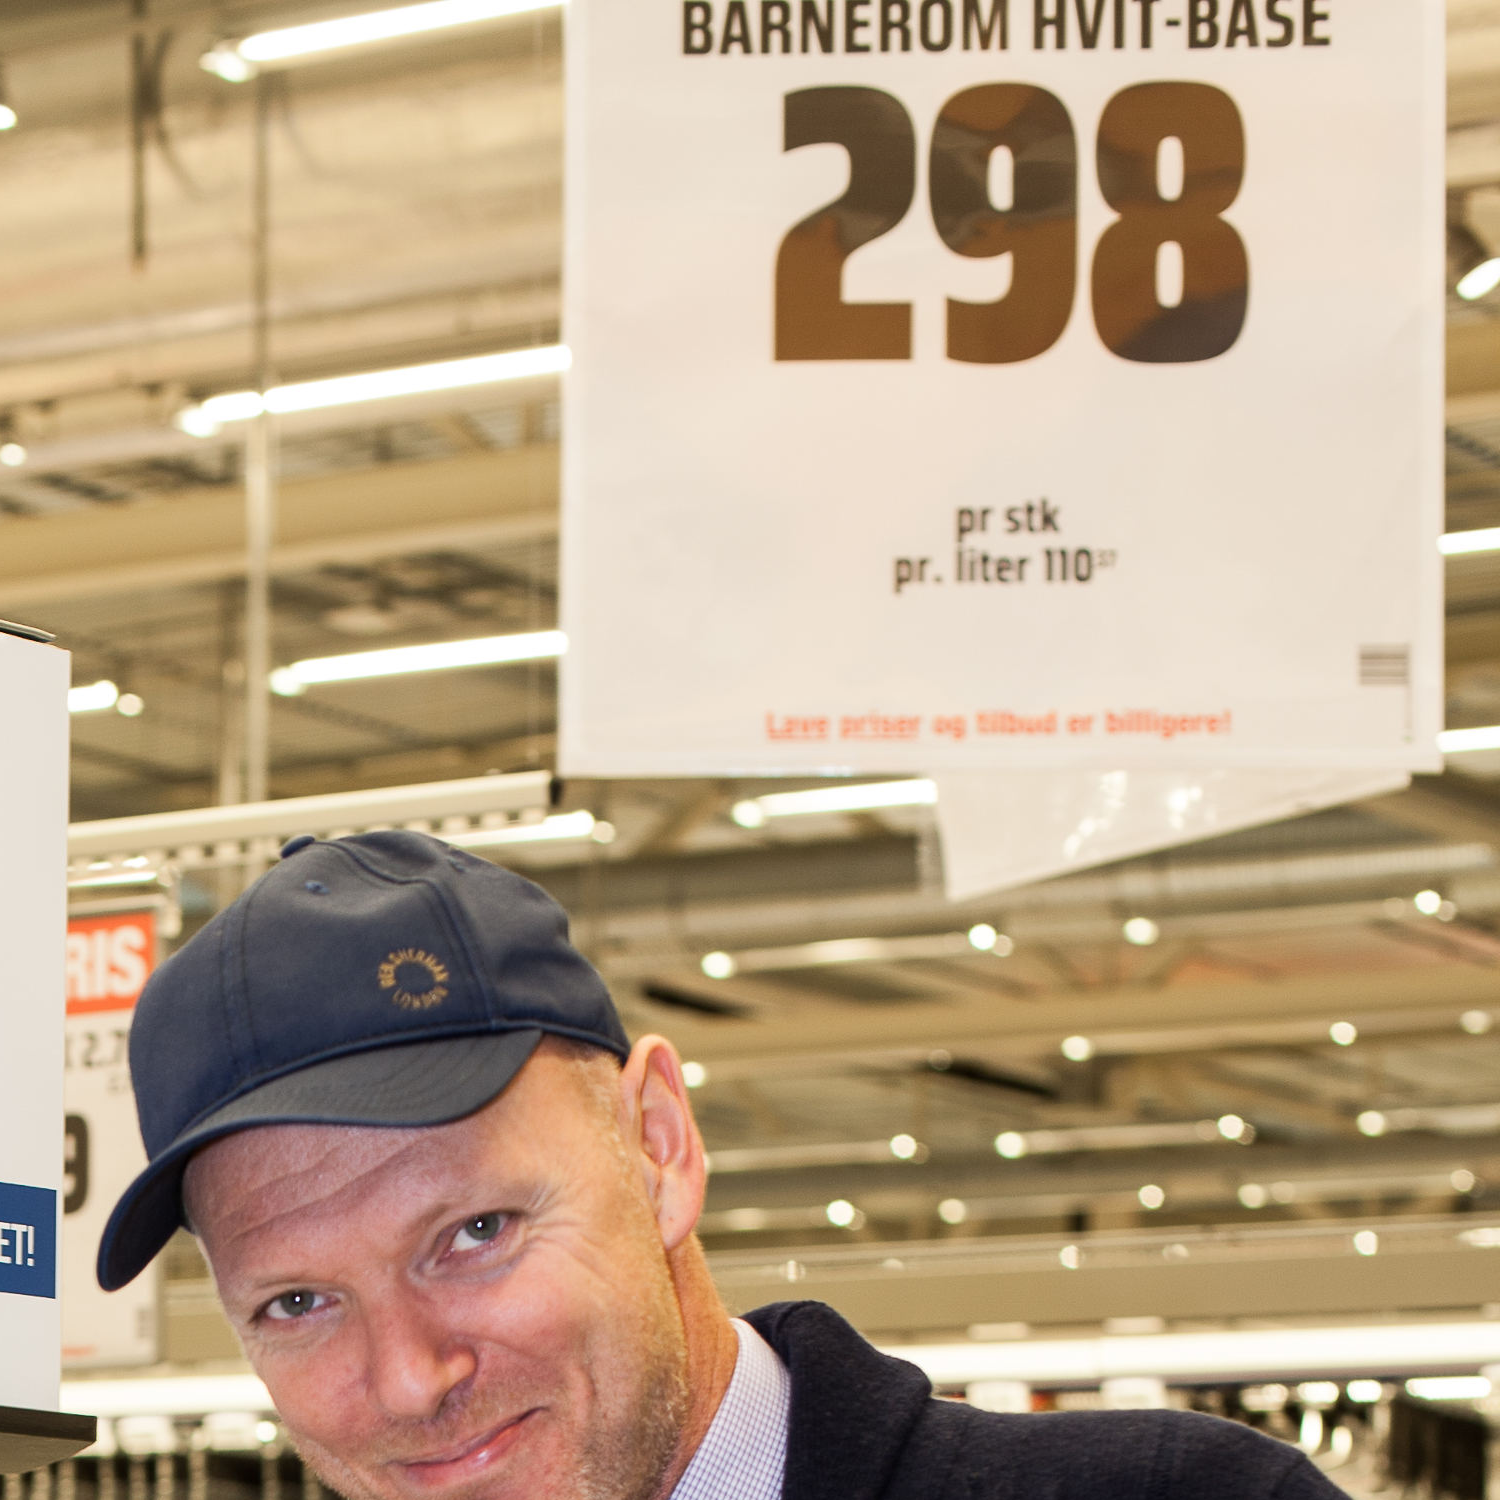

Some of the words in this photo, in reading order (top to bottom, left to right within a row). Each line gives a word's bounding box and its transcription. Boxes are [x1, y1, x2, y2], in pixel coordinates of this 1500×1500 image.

[773, 80, 1250, 364] 298
[955, 504, 994, 543] pr
[1004, 498, 1061, 534] stk
[893, 555, 943, 595] pr.
[954, 547, 1029, 584] liter
